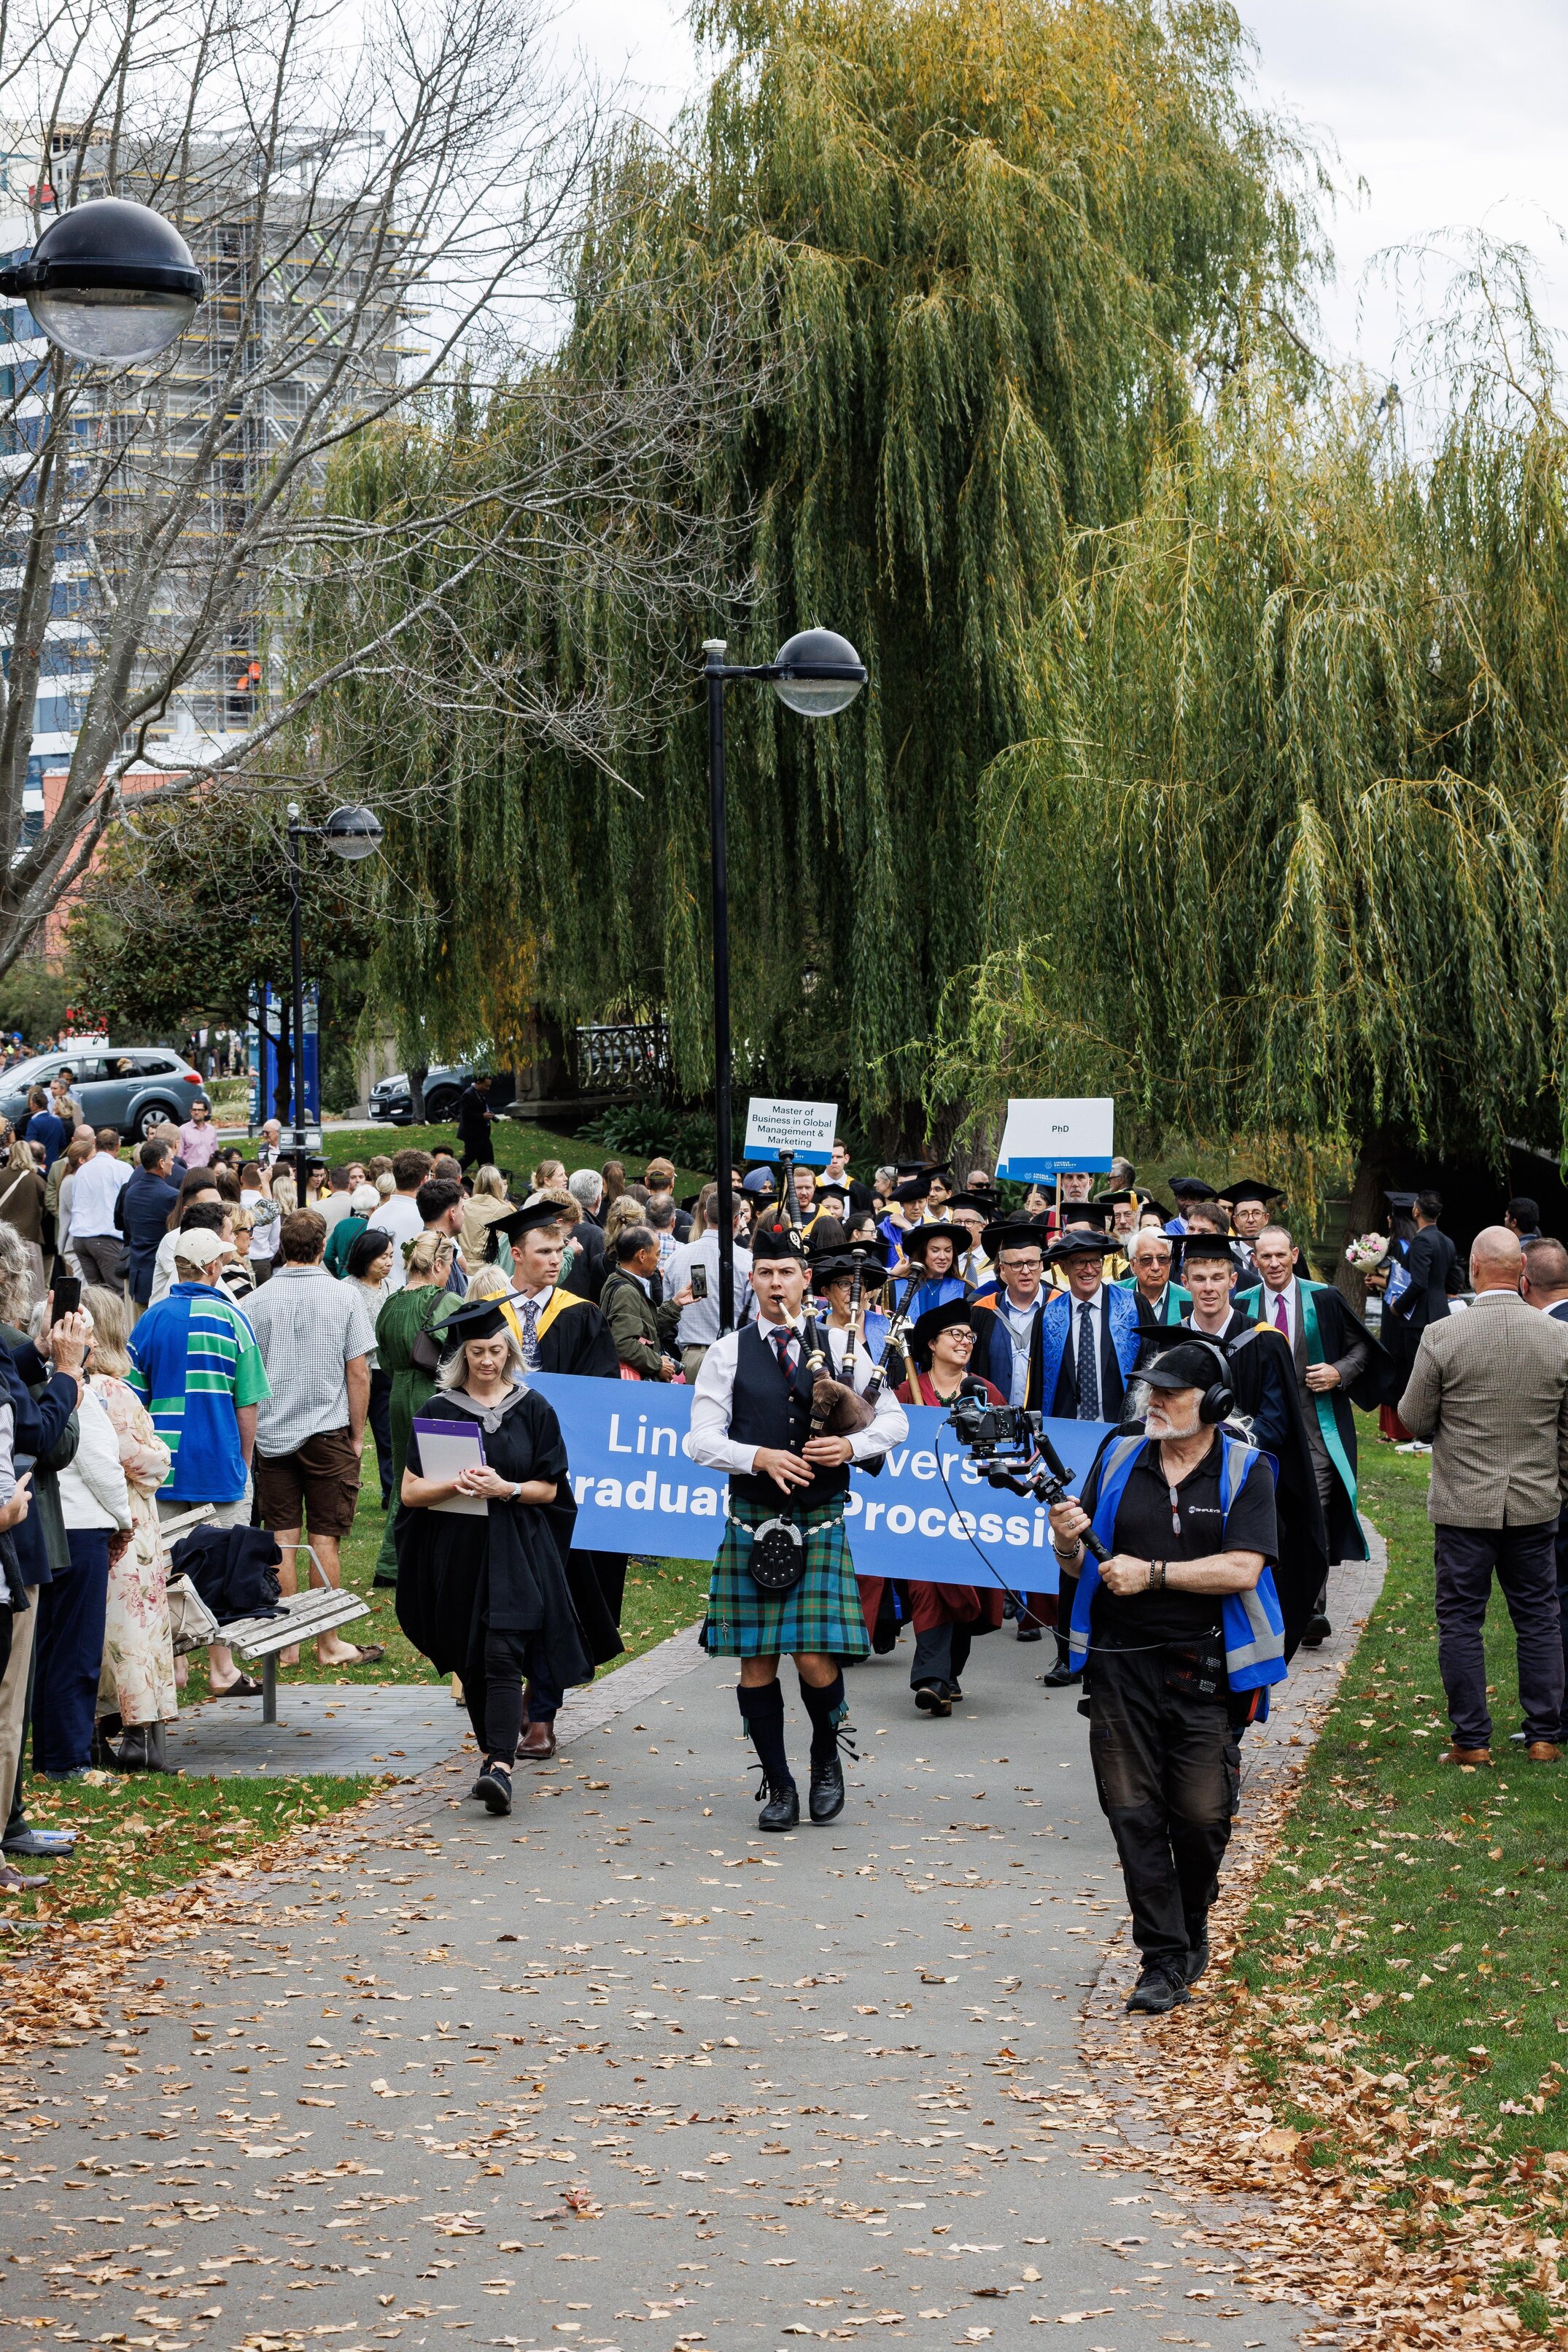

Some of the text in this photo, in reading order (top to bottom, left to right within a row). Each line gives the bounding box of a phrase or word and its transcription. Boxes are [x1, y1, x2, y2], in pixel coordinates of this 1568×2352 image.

[772, 1106, 814, 1116] Master of
[752, 1114, 791, 1124] Business
[803, 1118, 831, 1127] Global
[757, 1125, 824, 1137] Management &
[767, 1136, 812, 1148] Marketing
